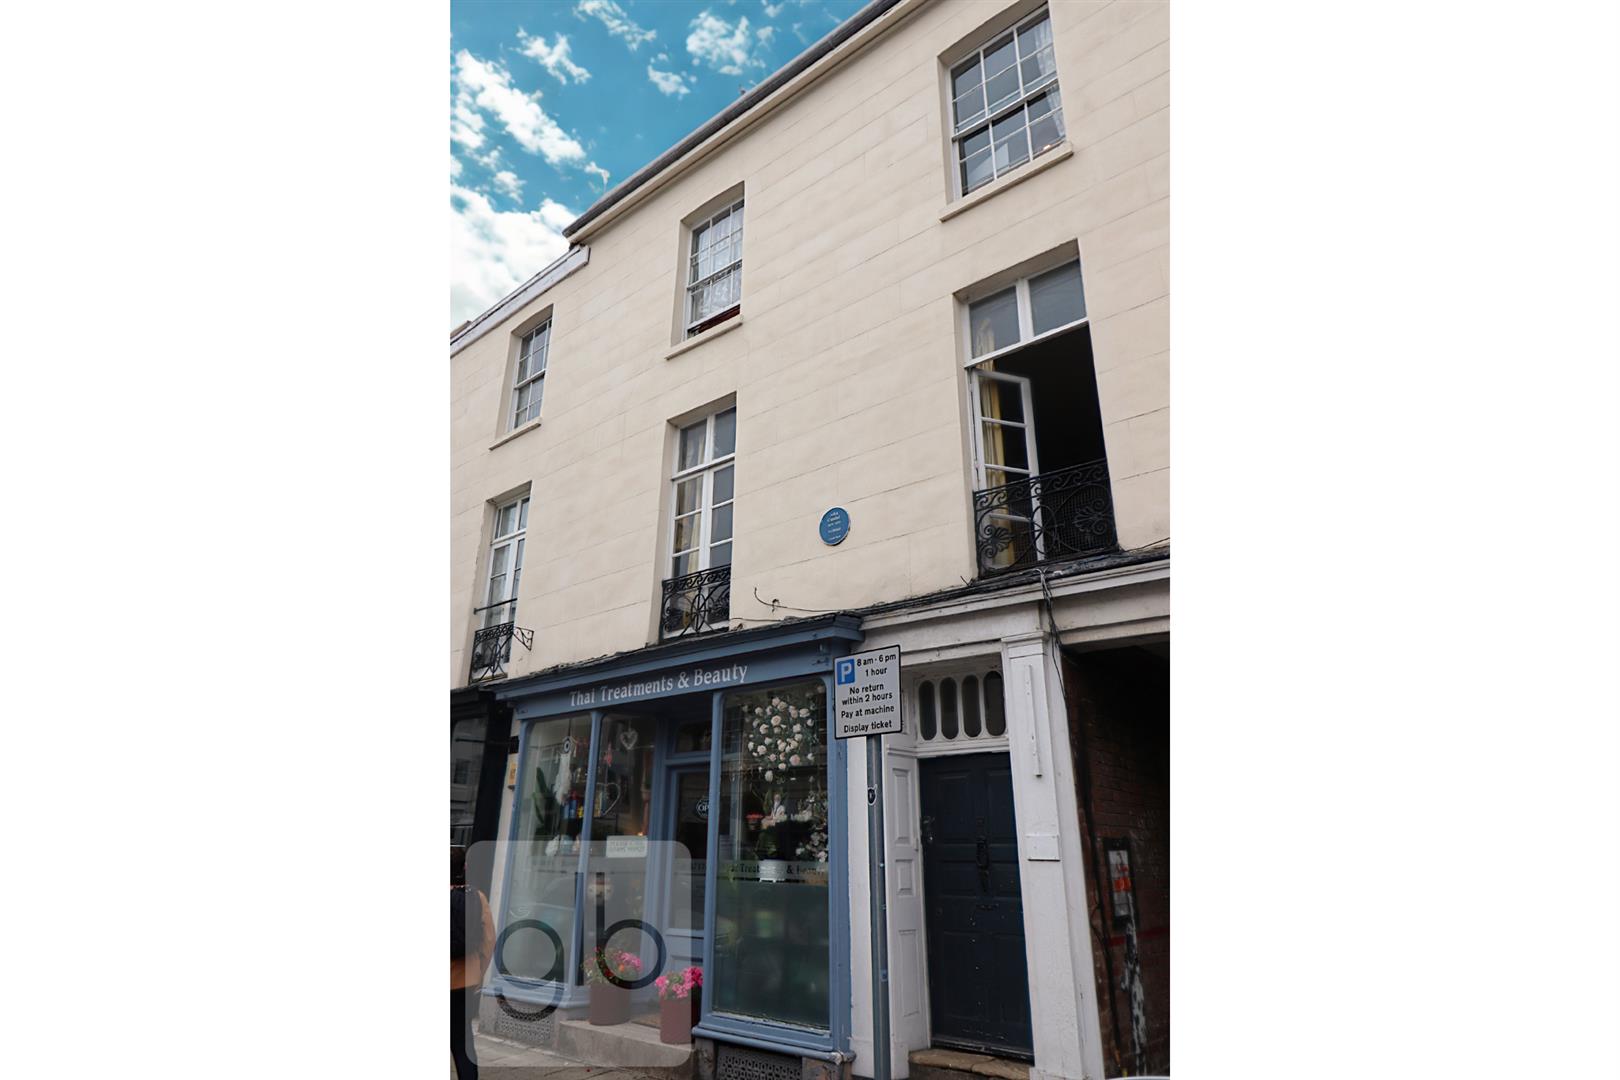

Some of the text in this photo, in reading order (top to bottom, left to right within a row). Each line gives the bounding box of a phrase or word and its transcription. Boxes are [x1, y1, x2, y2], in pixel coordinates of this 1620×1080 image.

[870, 667, 888, 677] hour
[569, 664, 749, 707] Thai Treatments & Beauty
[849, 683, 885, 695] No return
[842, 692, 893, 706] within 2 hours
[841, 704, 895, 719] Pay at machine
[843, 719, 892, 733] Display ticket
